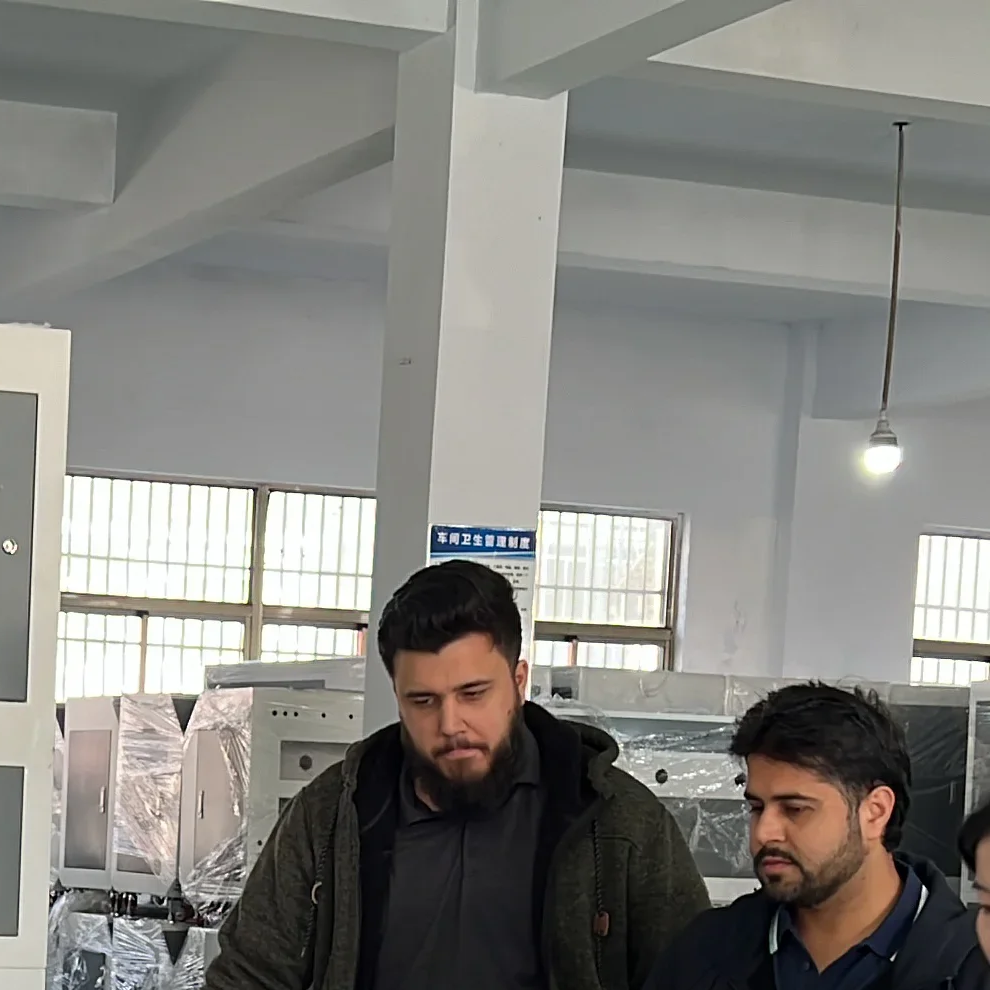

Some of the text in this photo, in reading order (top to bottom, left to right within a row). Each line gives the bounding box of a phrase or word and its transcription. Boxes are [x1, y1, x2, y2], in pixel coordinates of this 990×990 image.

[437, 532, 530, 549] 车间卫生管理制度
